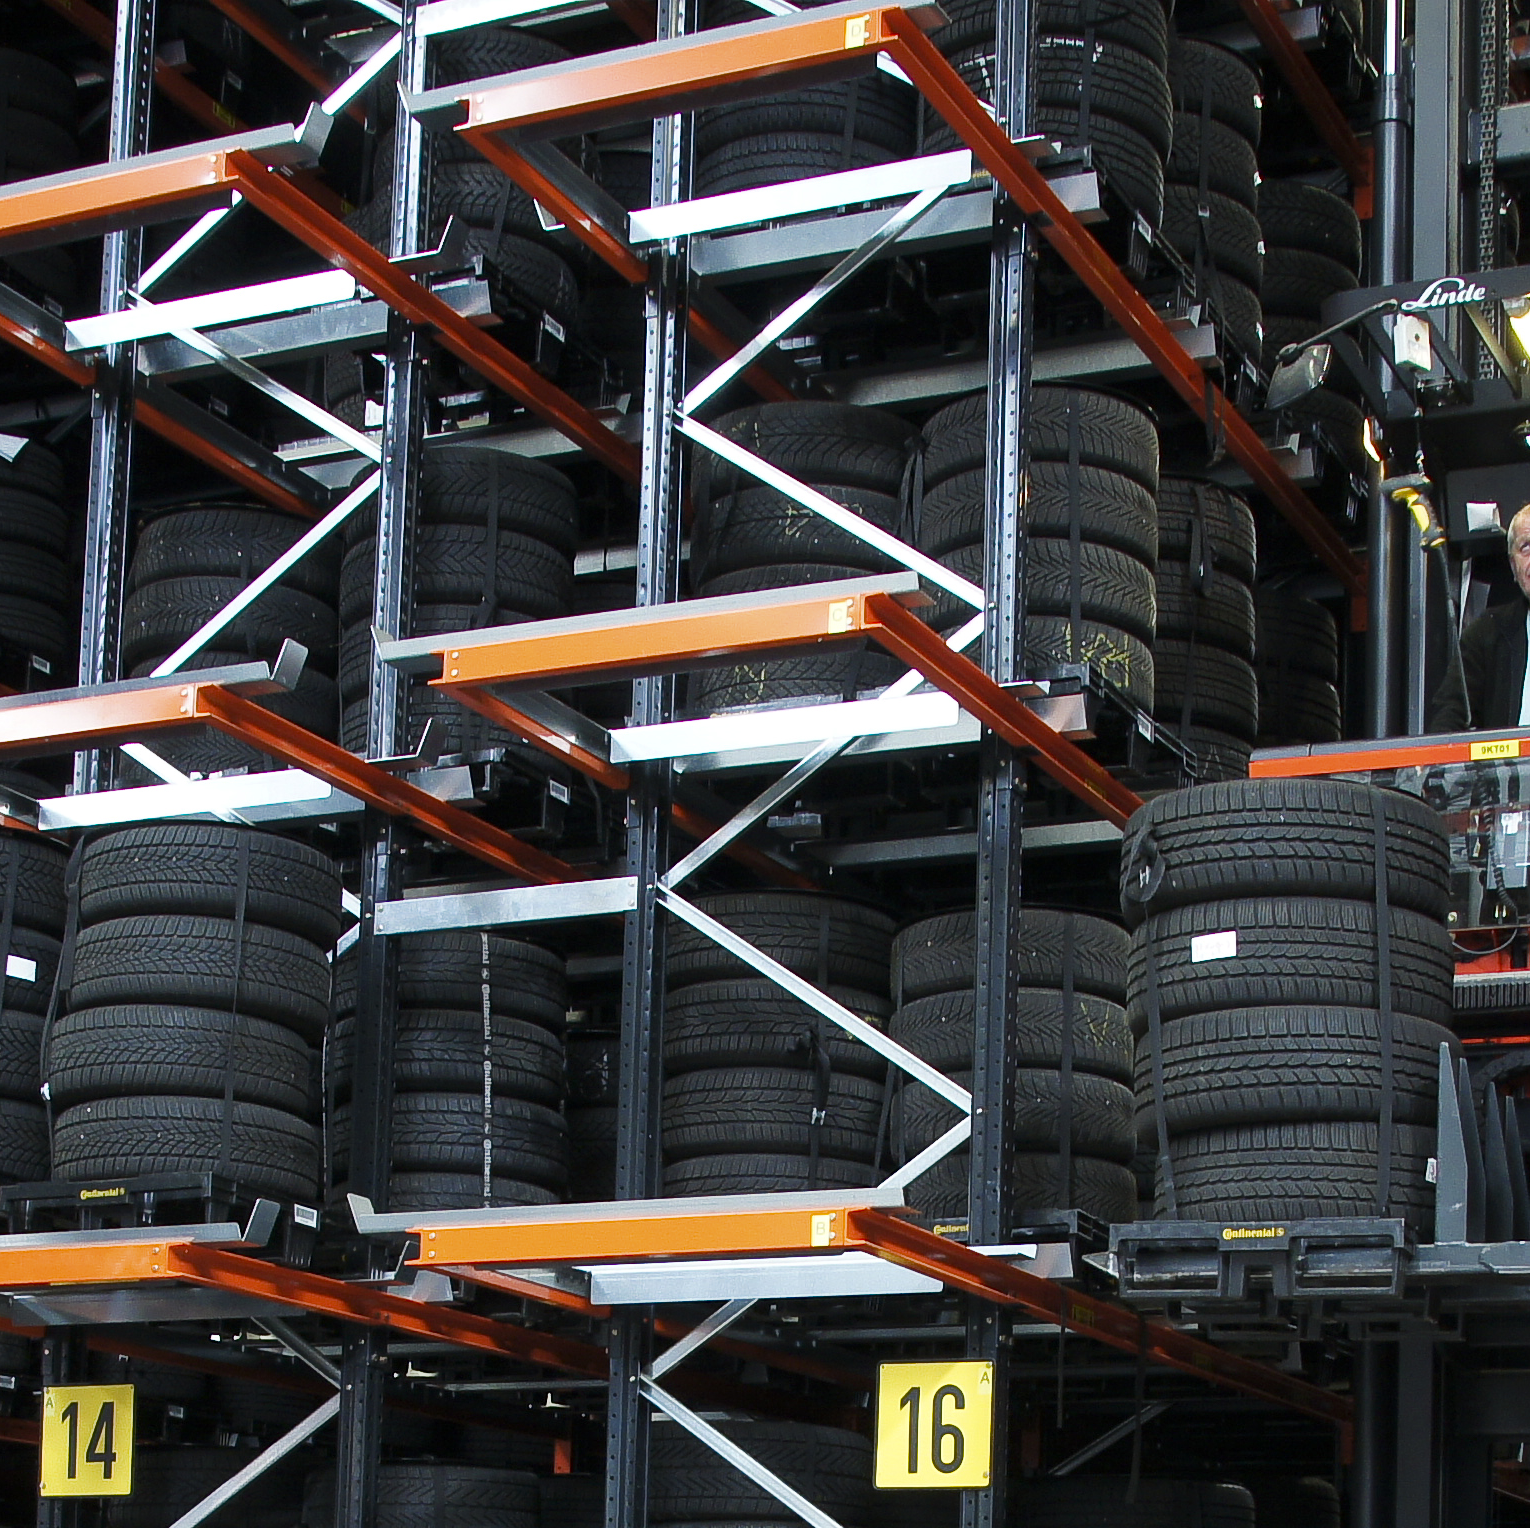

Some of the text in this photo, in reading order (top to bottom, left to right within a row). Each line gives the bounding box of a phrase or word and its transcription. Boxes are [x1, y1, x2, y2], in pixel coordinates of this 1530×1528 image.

[1401, 277, 1486, 313] Linde
[1222, 1228, 1275, 1241] Continental
[980, 1371, 991, 1385] A
[61, 1401, 118, 1480] 14
[899, 1384, 965, 1474] 16
